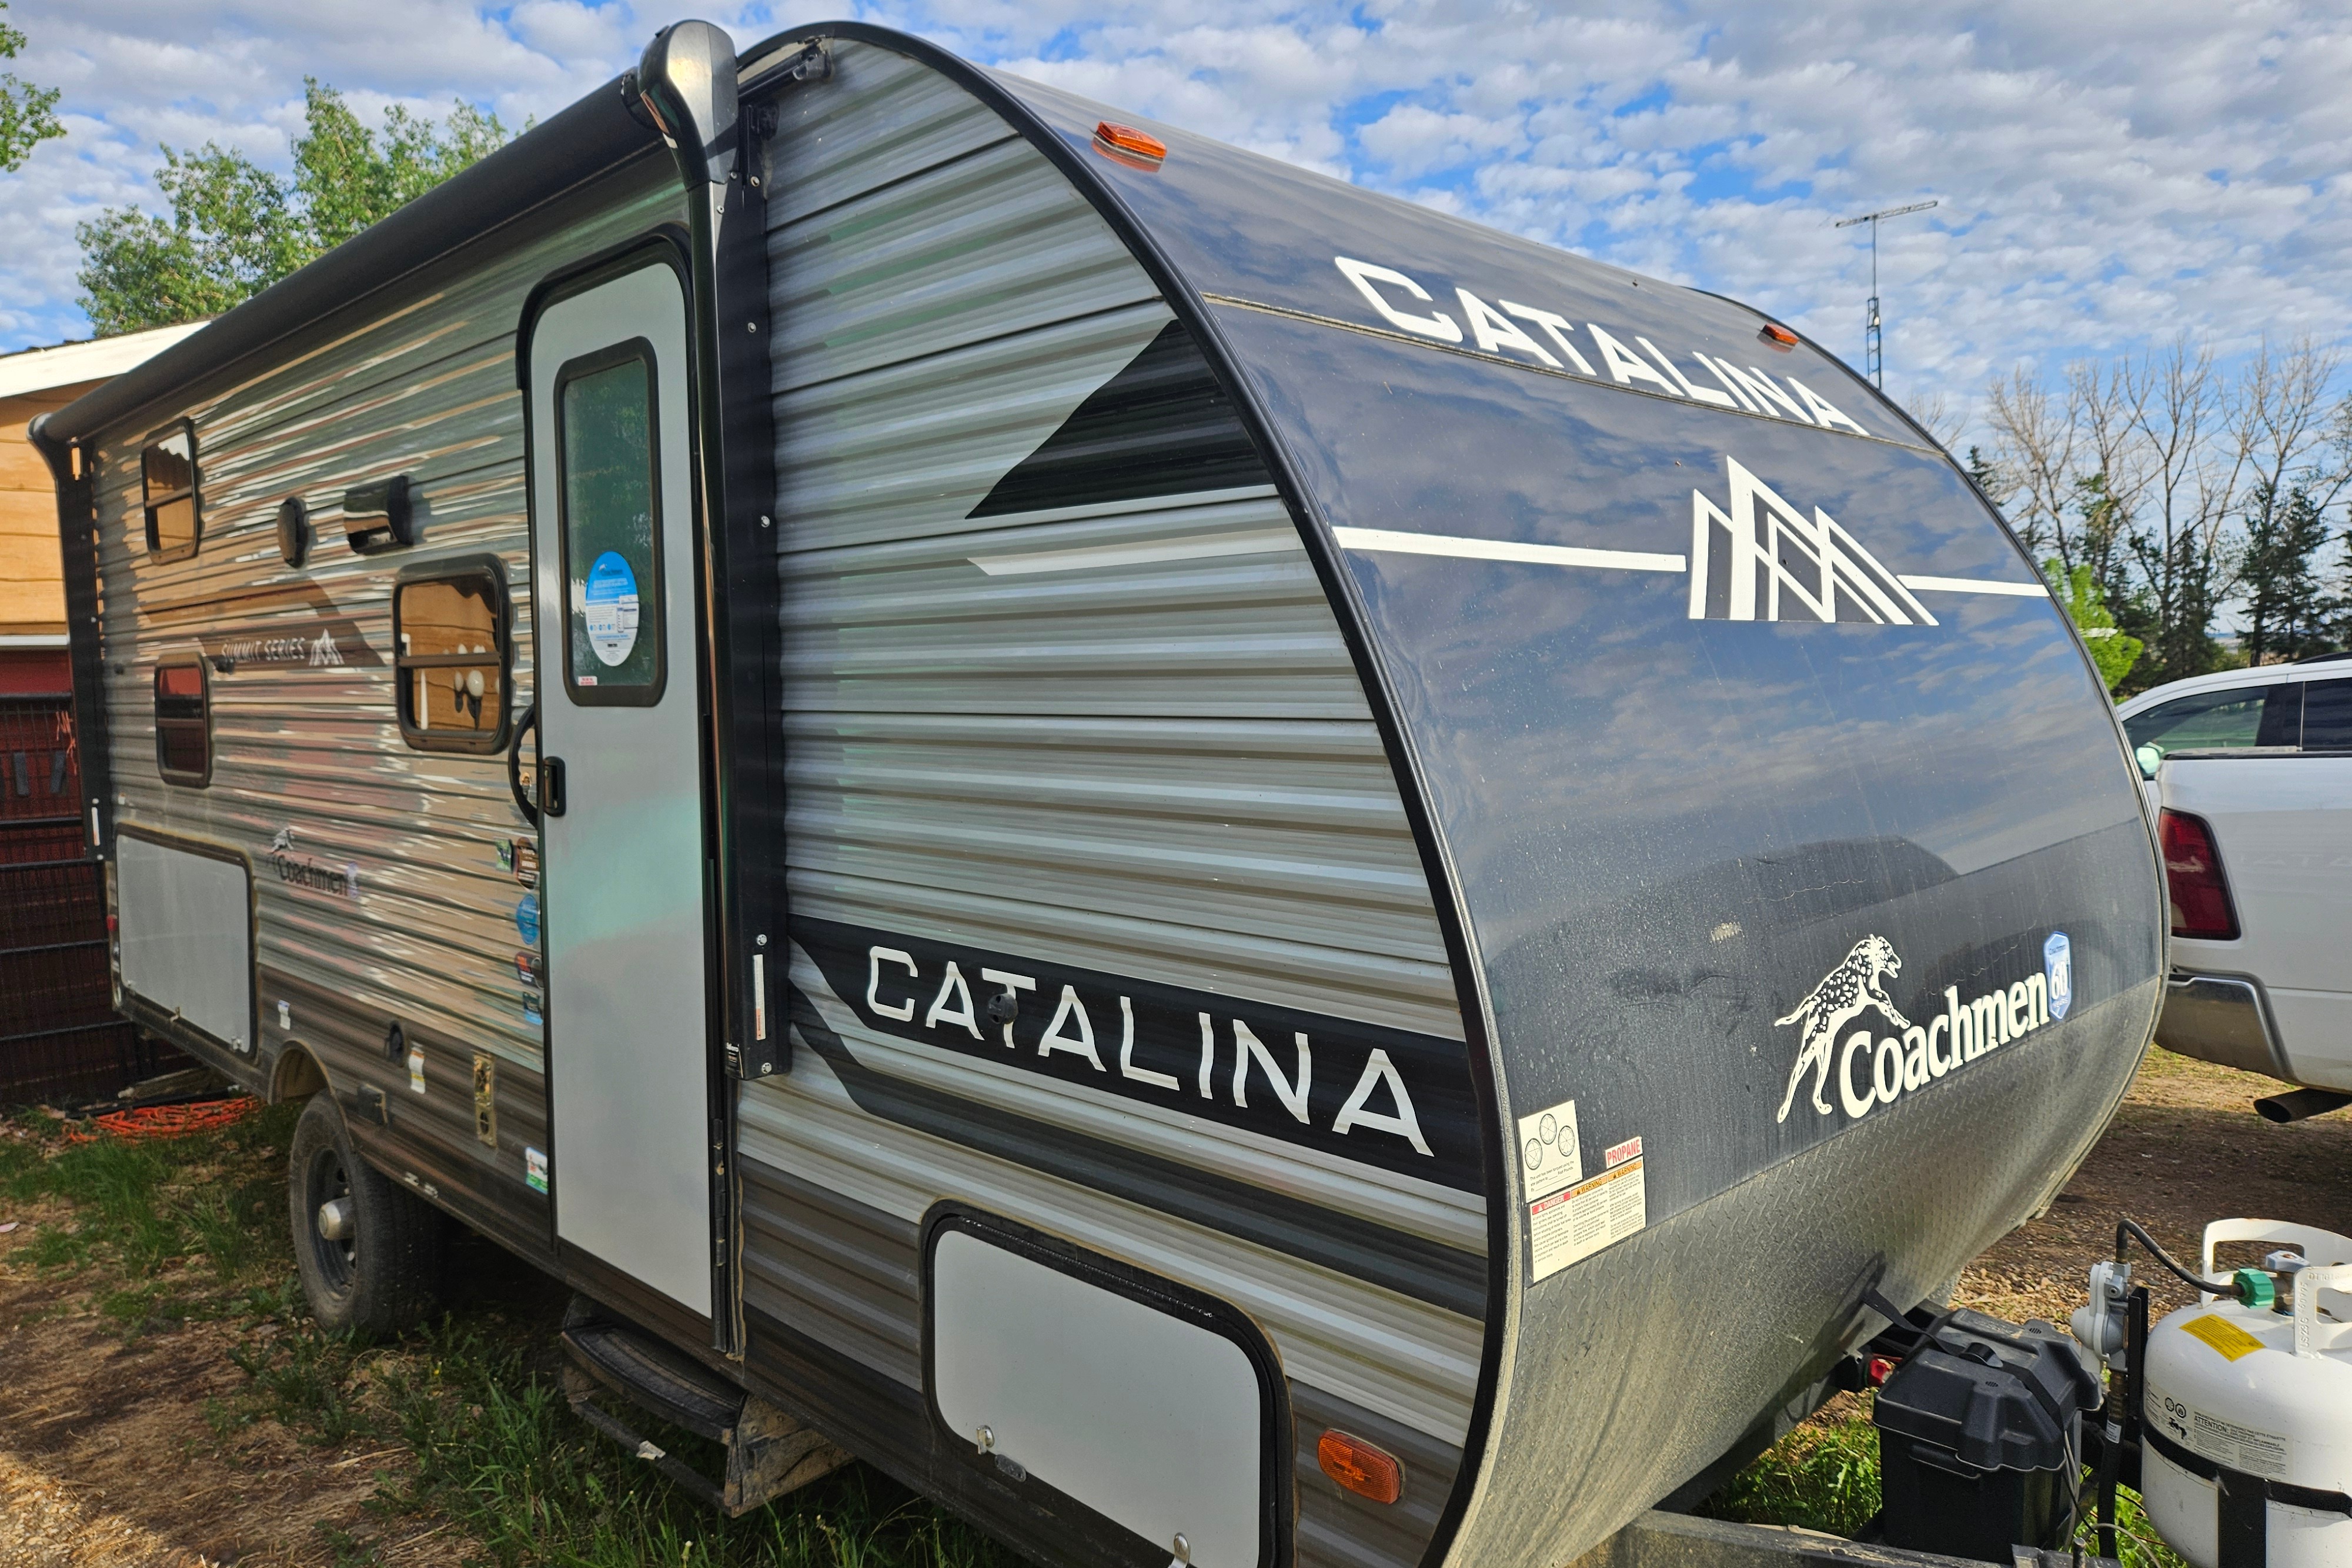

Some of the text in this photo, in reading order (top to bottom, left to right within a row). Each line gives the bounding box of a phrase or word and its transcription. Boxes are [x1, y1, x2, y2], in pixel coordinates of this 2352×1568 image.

[1335, 256, 1869, 436] CATALINA
[222, 637, 306, 661] SUMMIT SERIES
[278, 854, 348, 896] Coachmen
[2051, 961, 2068, 1000] 60
[867, 946, 1434, 1157] CATALINA
[1840, 972, 2050, 1118] Coachmen
[1607, 1139, 1641, 1166] PROPANE
[1617, 1163, 1637, 1176] WARNING
[1581, 1178, 1602, 1192] WARNING
[1544, 1196, 1564, 1208] DANGER
[2194, 1416, 2229, 1433] ATTENTION:
